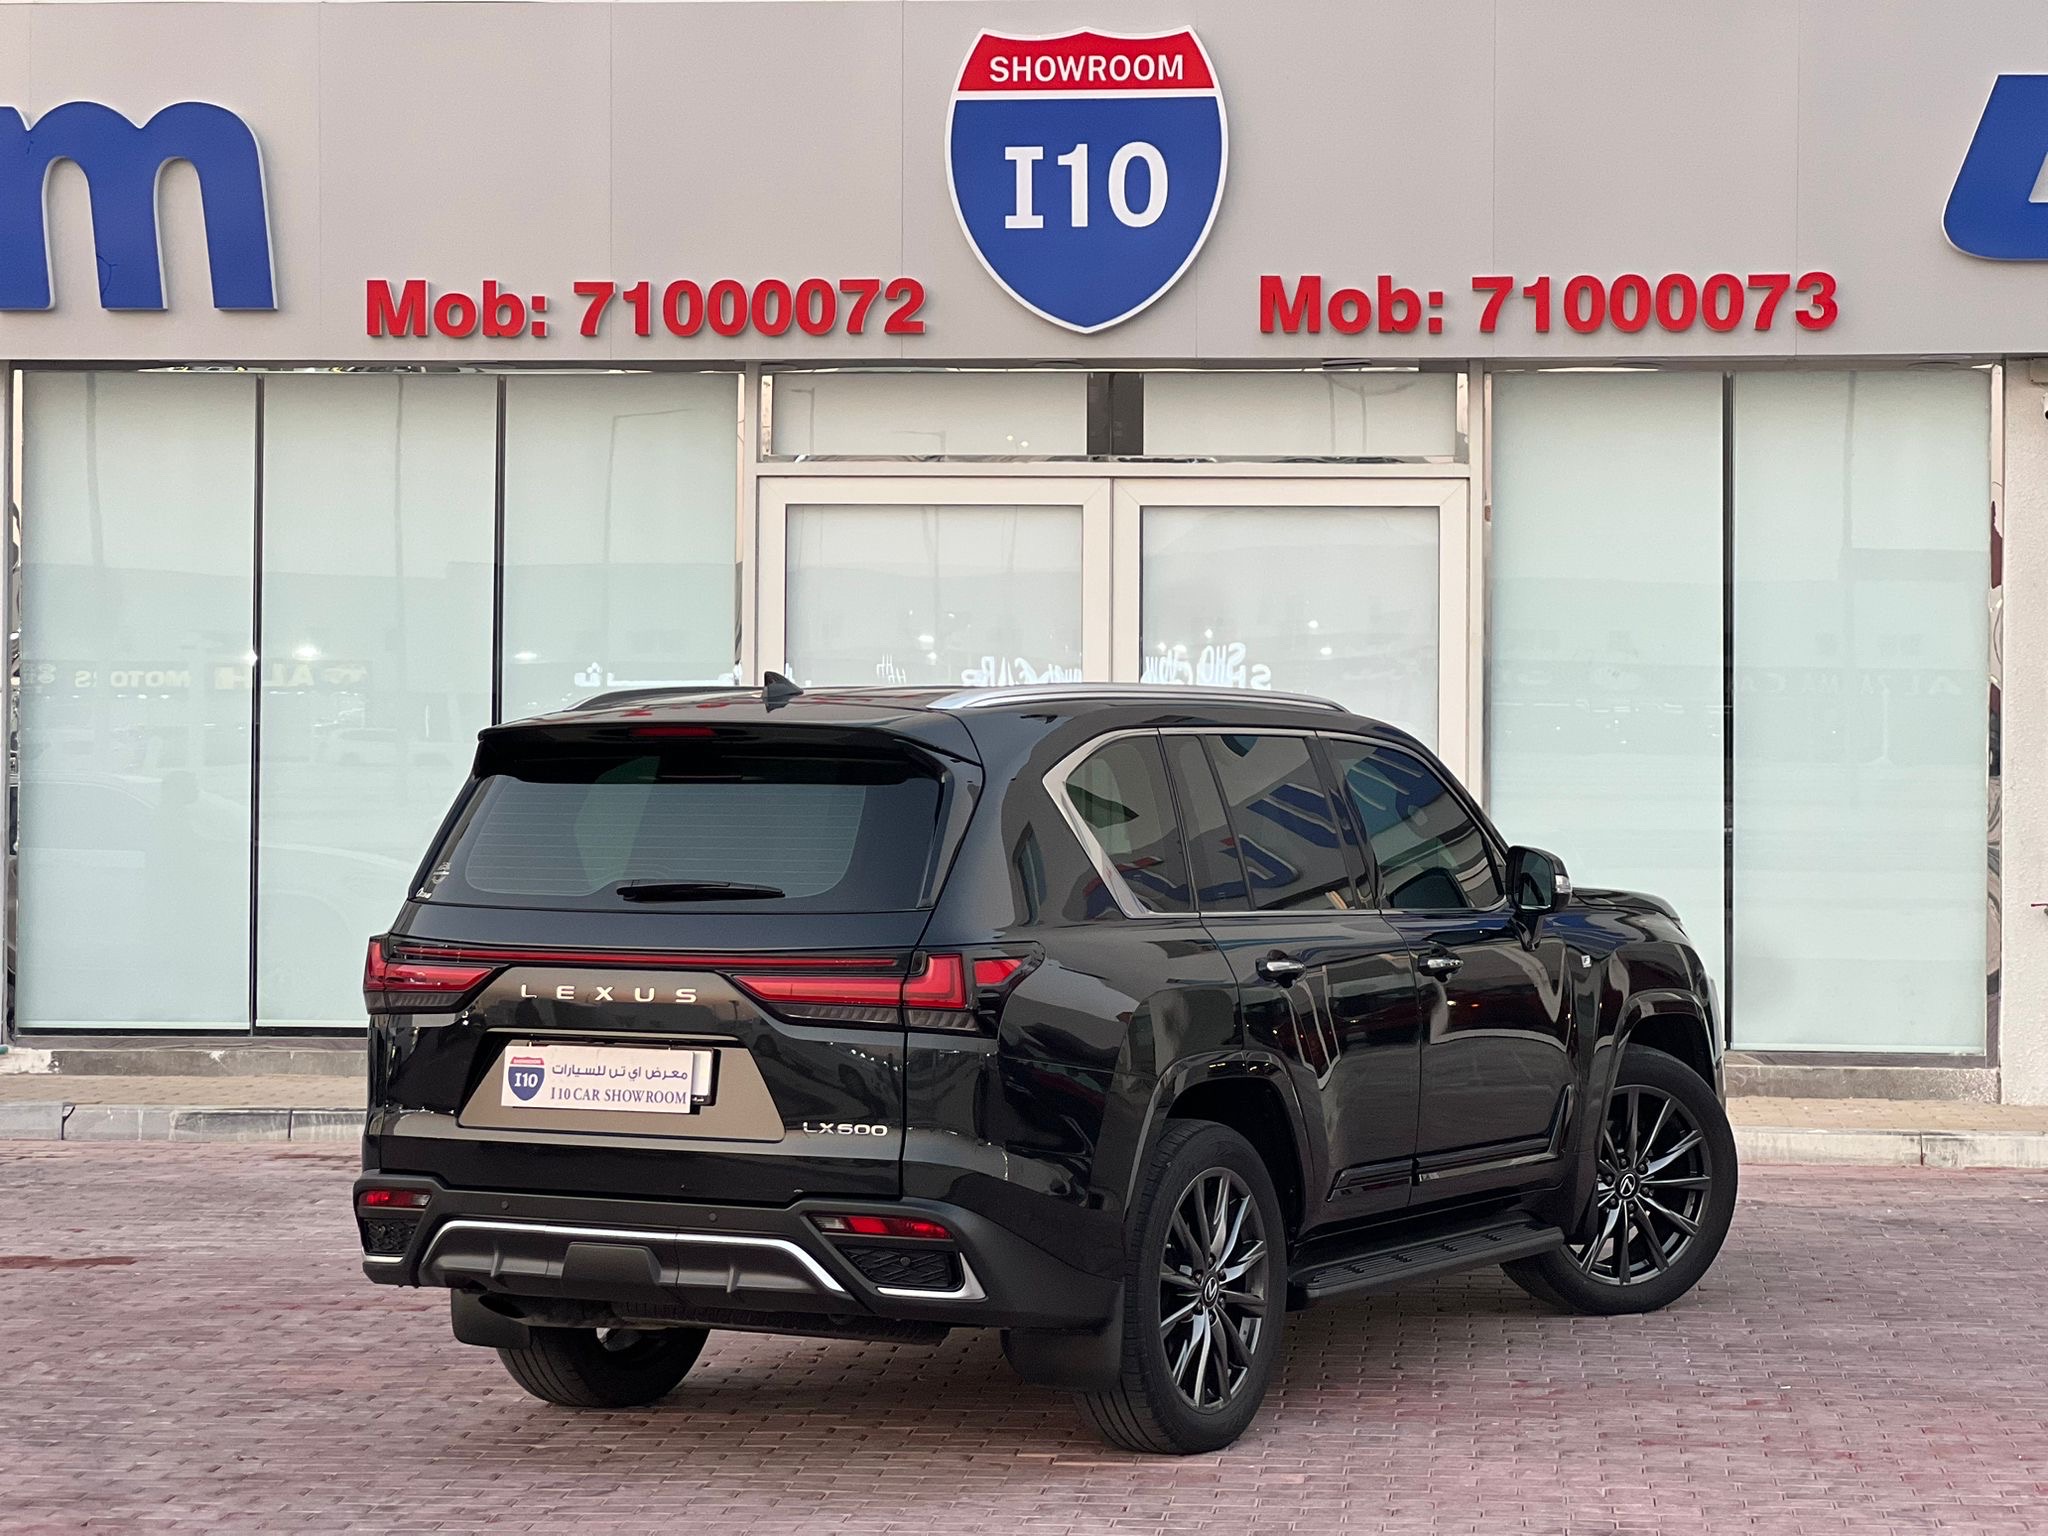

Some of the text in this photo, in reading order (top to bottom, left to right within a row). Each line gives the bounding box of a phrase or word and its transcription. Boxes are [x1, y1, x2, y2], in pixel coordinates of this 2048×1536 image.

[989, 54, 1184, 82] SHOWROOM
[1004, 141, 1169, 229] I10
[366, 277, 927, 338] Mob: 71000072
[1259, 271, 1839, 334] Mob: 71000073
[520, 984, 698, 1003] LEXUS
[514, 1072, 539, 1088] I10
[551, 1064, 606, 1078] للسيارات
[645, 1066, 688, 1080] معرض
[573, 1088, 600, 1102] CAR
[604, 1089, 687, 1104] SHOWROOM
